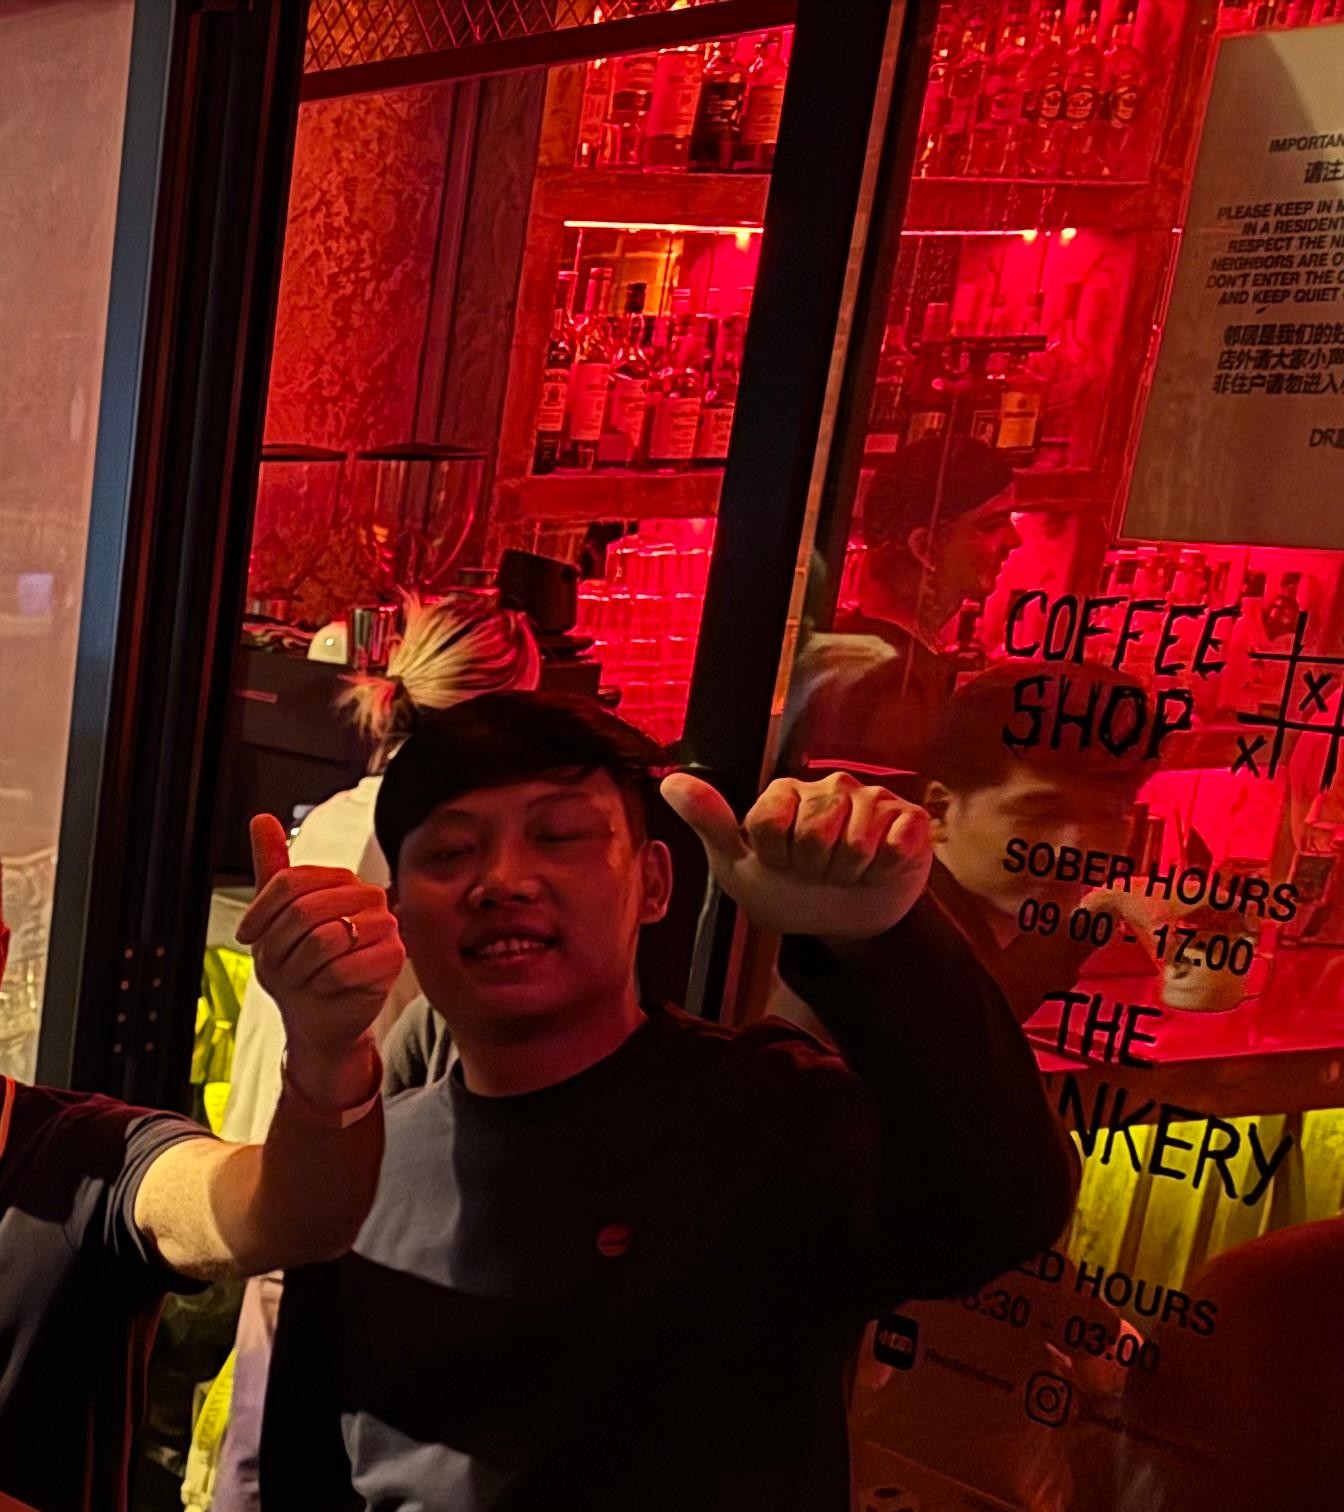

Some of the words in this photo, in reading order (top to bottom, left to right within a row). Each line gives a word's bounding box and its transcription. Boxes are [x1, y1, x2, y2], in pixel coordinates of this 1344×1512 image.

[1217, 204, 1272, 220] PLEASE
[1274, 201, 1313, 216] KEEP
[1317, 200, 1332, 214] IN
[1242, 221, 1257, 236] IN
[1260, 221, 1269, 234] A
[1211, 255, 1294, 271] NEIGHBORS
[1296, 253, 1329, 268] ARE
[1227, 237, 1293, 254] RESPECT
[1298, 235, 1327, 250] THE
[1206, 273, 1250, 288] DON'T
[1252, 272, 1300, 287] ENTER
[1306, 270, 1334, 286] THE
[1218, 290, 1249, 305] AND
[1252, 289, 1291, 303] KEEP
[1295, 288, 1340, 303] QUIET
[1212, 372, 1344, 394] 非住户请勿进入
[1006, 590, 1241, 678] COFFEE
[1001, 674, 1194, 763] SHOP
[1002, 837, 1135, 893] SOBER
[1145, 863, 1298, 922] HOURS
[1018, 898, 1112, 947] 0900
[1152, 924, 1254, 976] 17:00
[1043, 991, 1162, 1069] THE
[1056, 1074, 1293, 1206] NKERY
[1074, 1261, 1218, 1336] HOURS
[1064, 1315, 1160, 1373] 03:00
